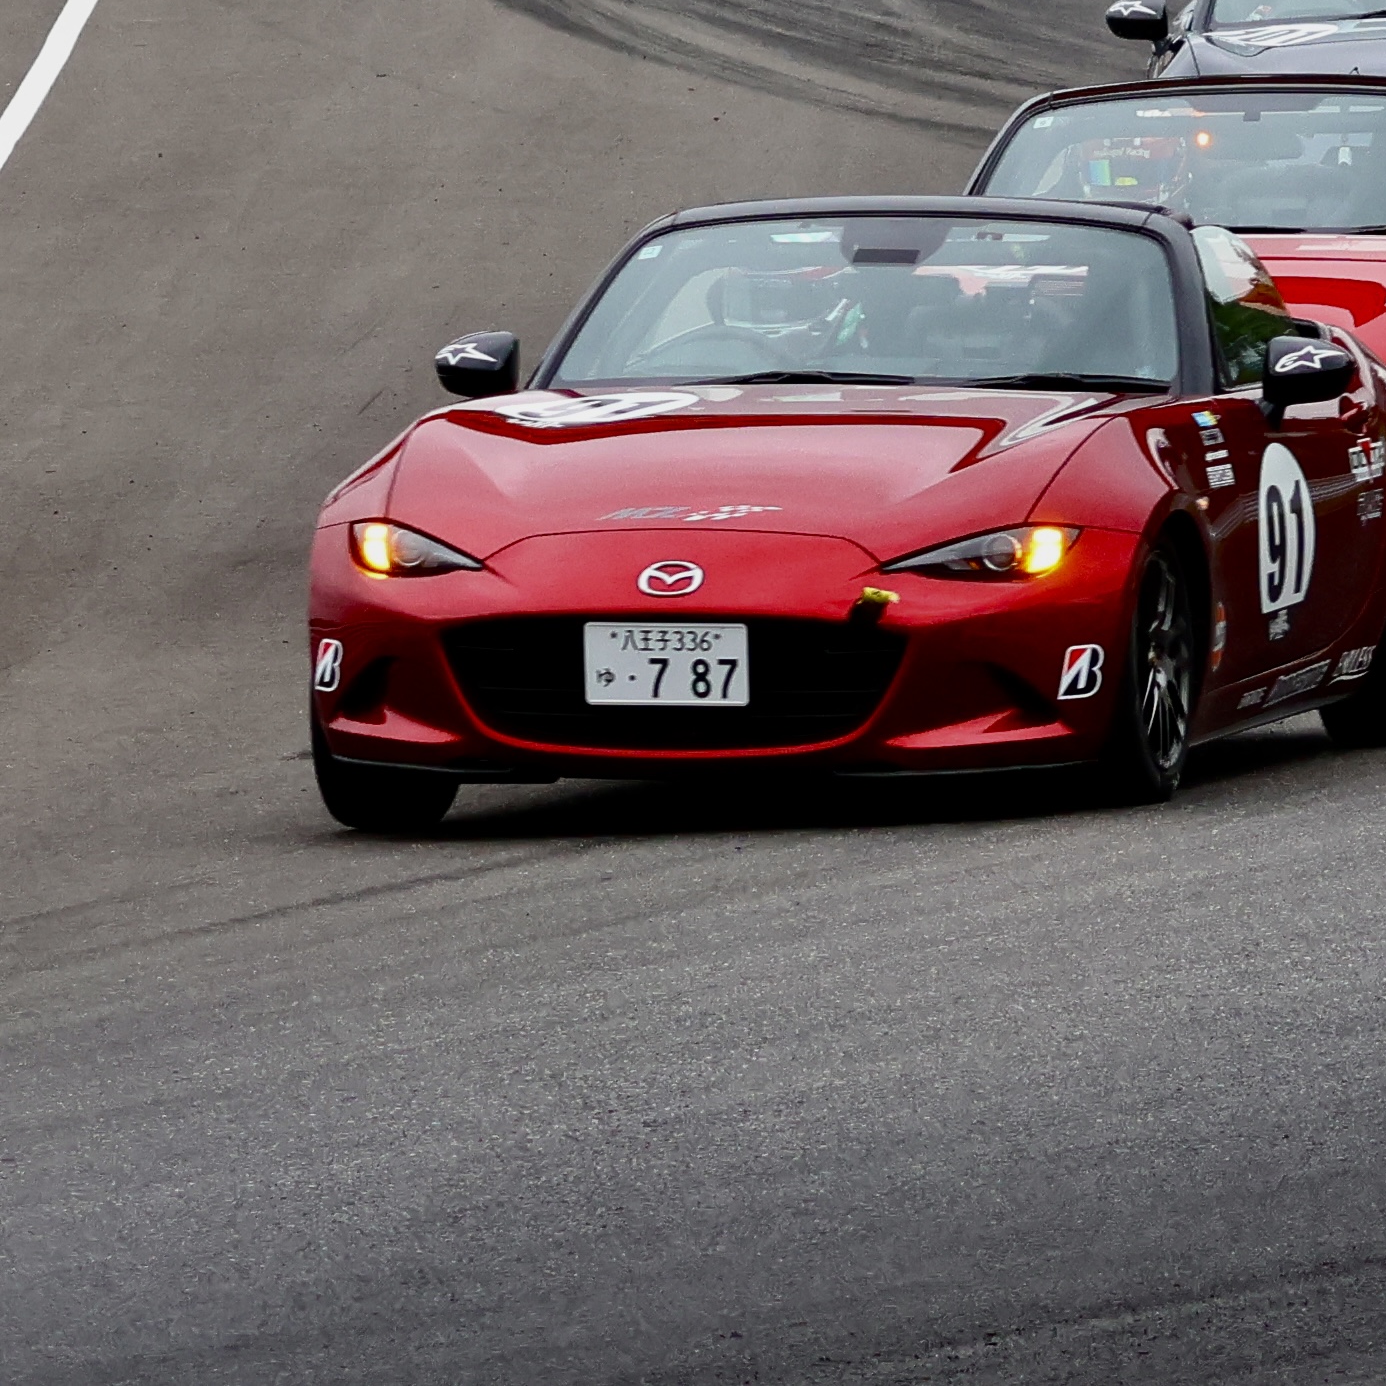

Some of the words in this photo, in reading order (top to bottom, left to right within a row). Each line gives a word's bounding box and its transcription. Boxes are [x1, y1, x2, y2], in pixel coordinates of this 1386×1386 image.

[1266, 478, 1305, 604] 91
[621, 630, 713, 652] 八王子336
[596, 668, 616, 687] ゆ
